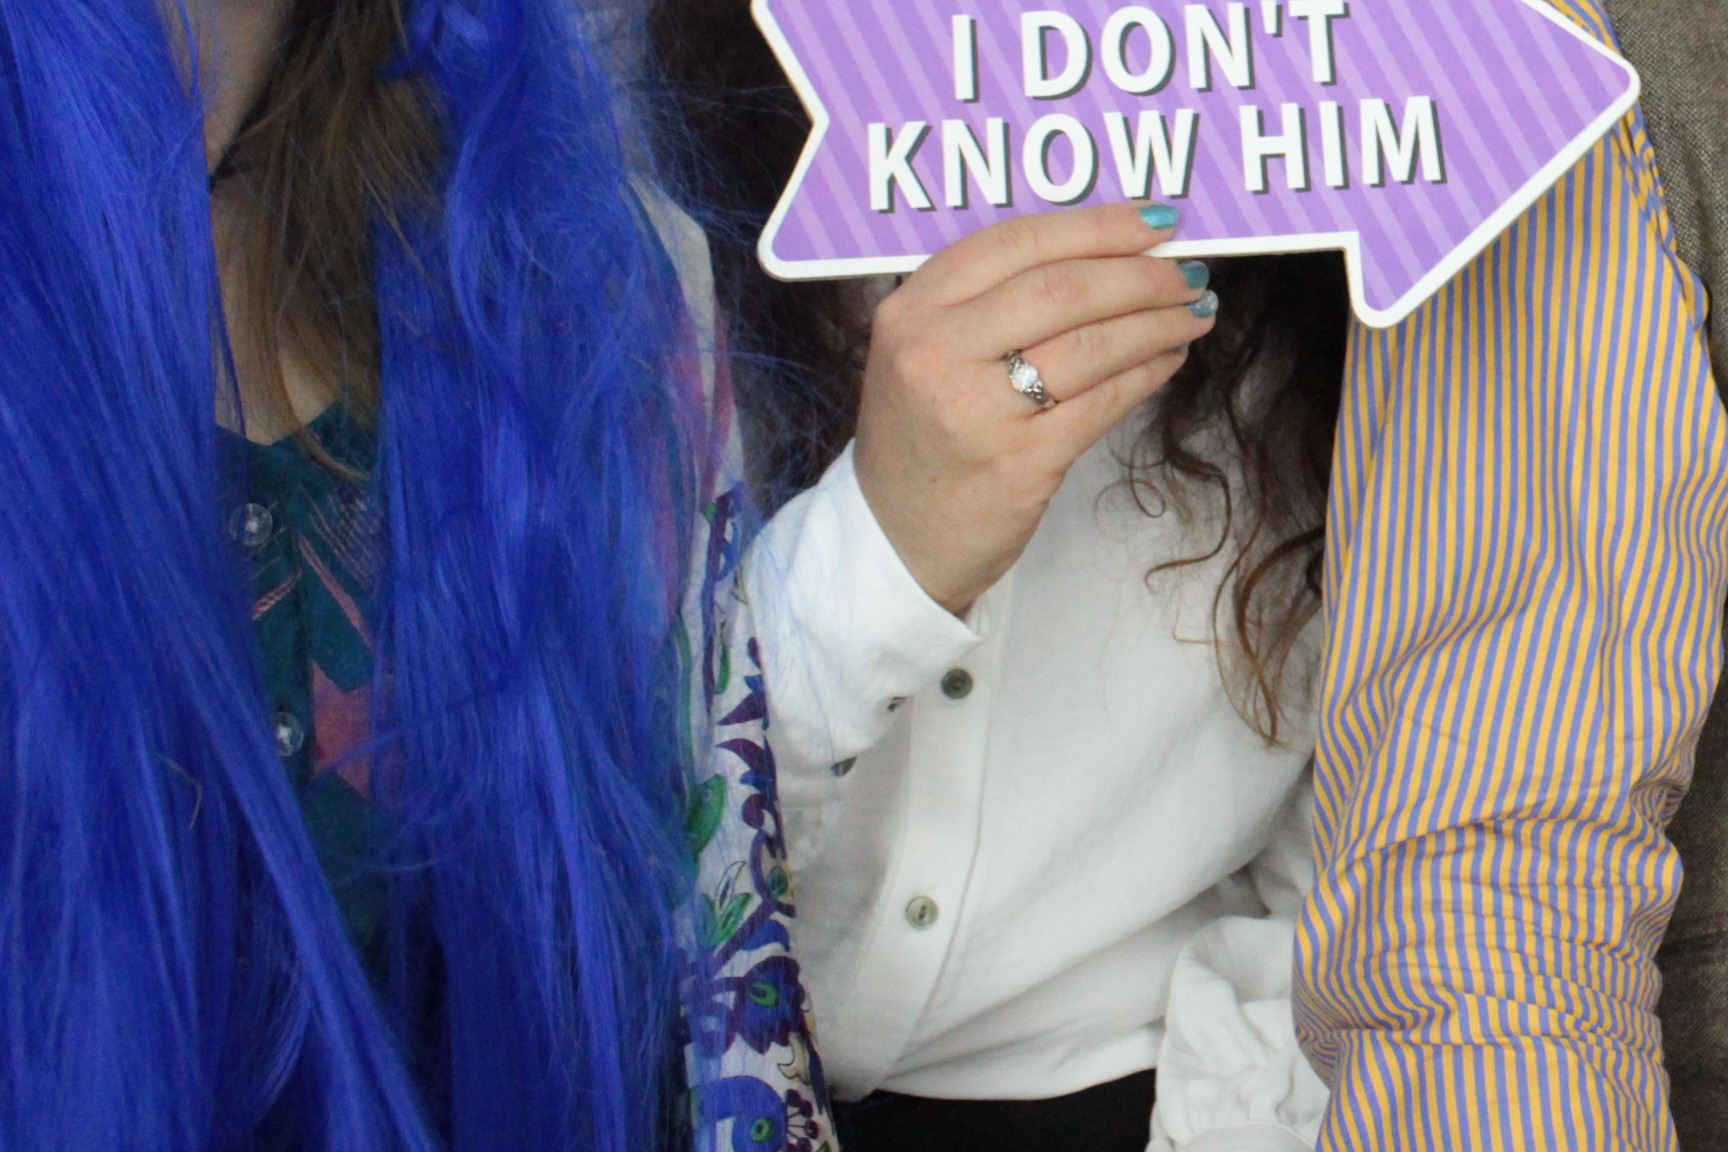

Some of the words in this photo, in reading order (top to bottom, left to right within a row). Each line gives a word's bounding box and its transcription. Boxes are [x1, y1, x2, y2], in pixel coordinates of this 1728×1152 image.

[951, 14, 976, 101] I
[867, 107, 1197, 212] KNOW
[1238, 95, 1444, 193] HIM
